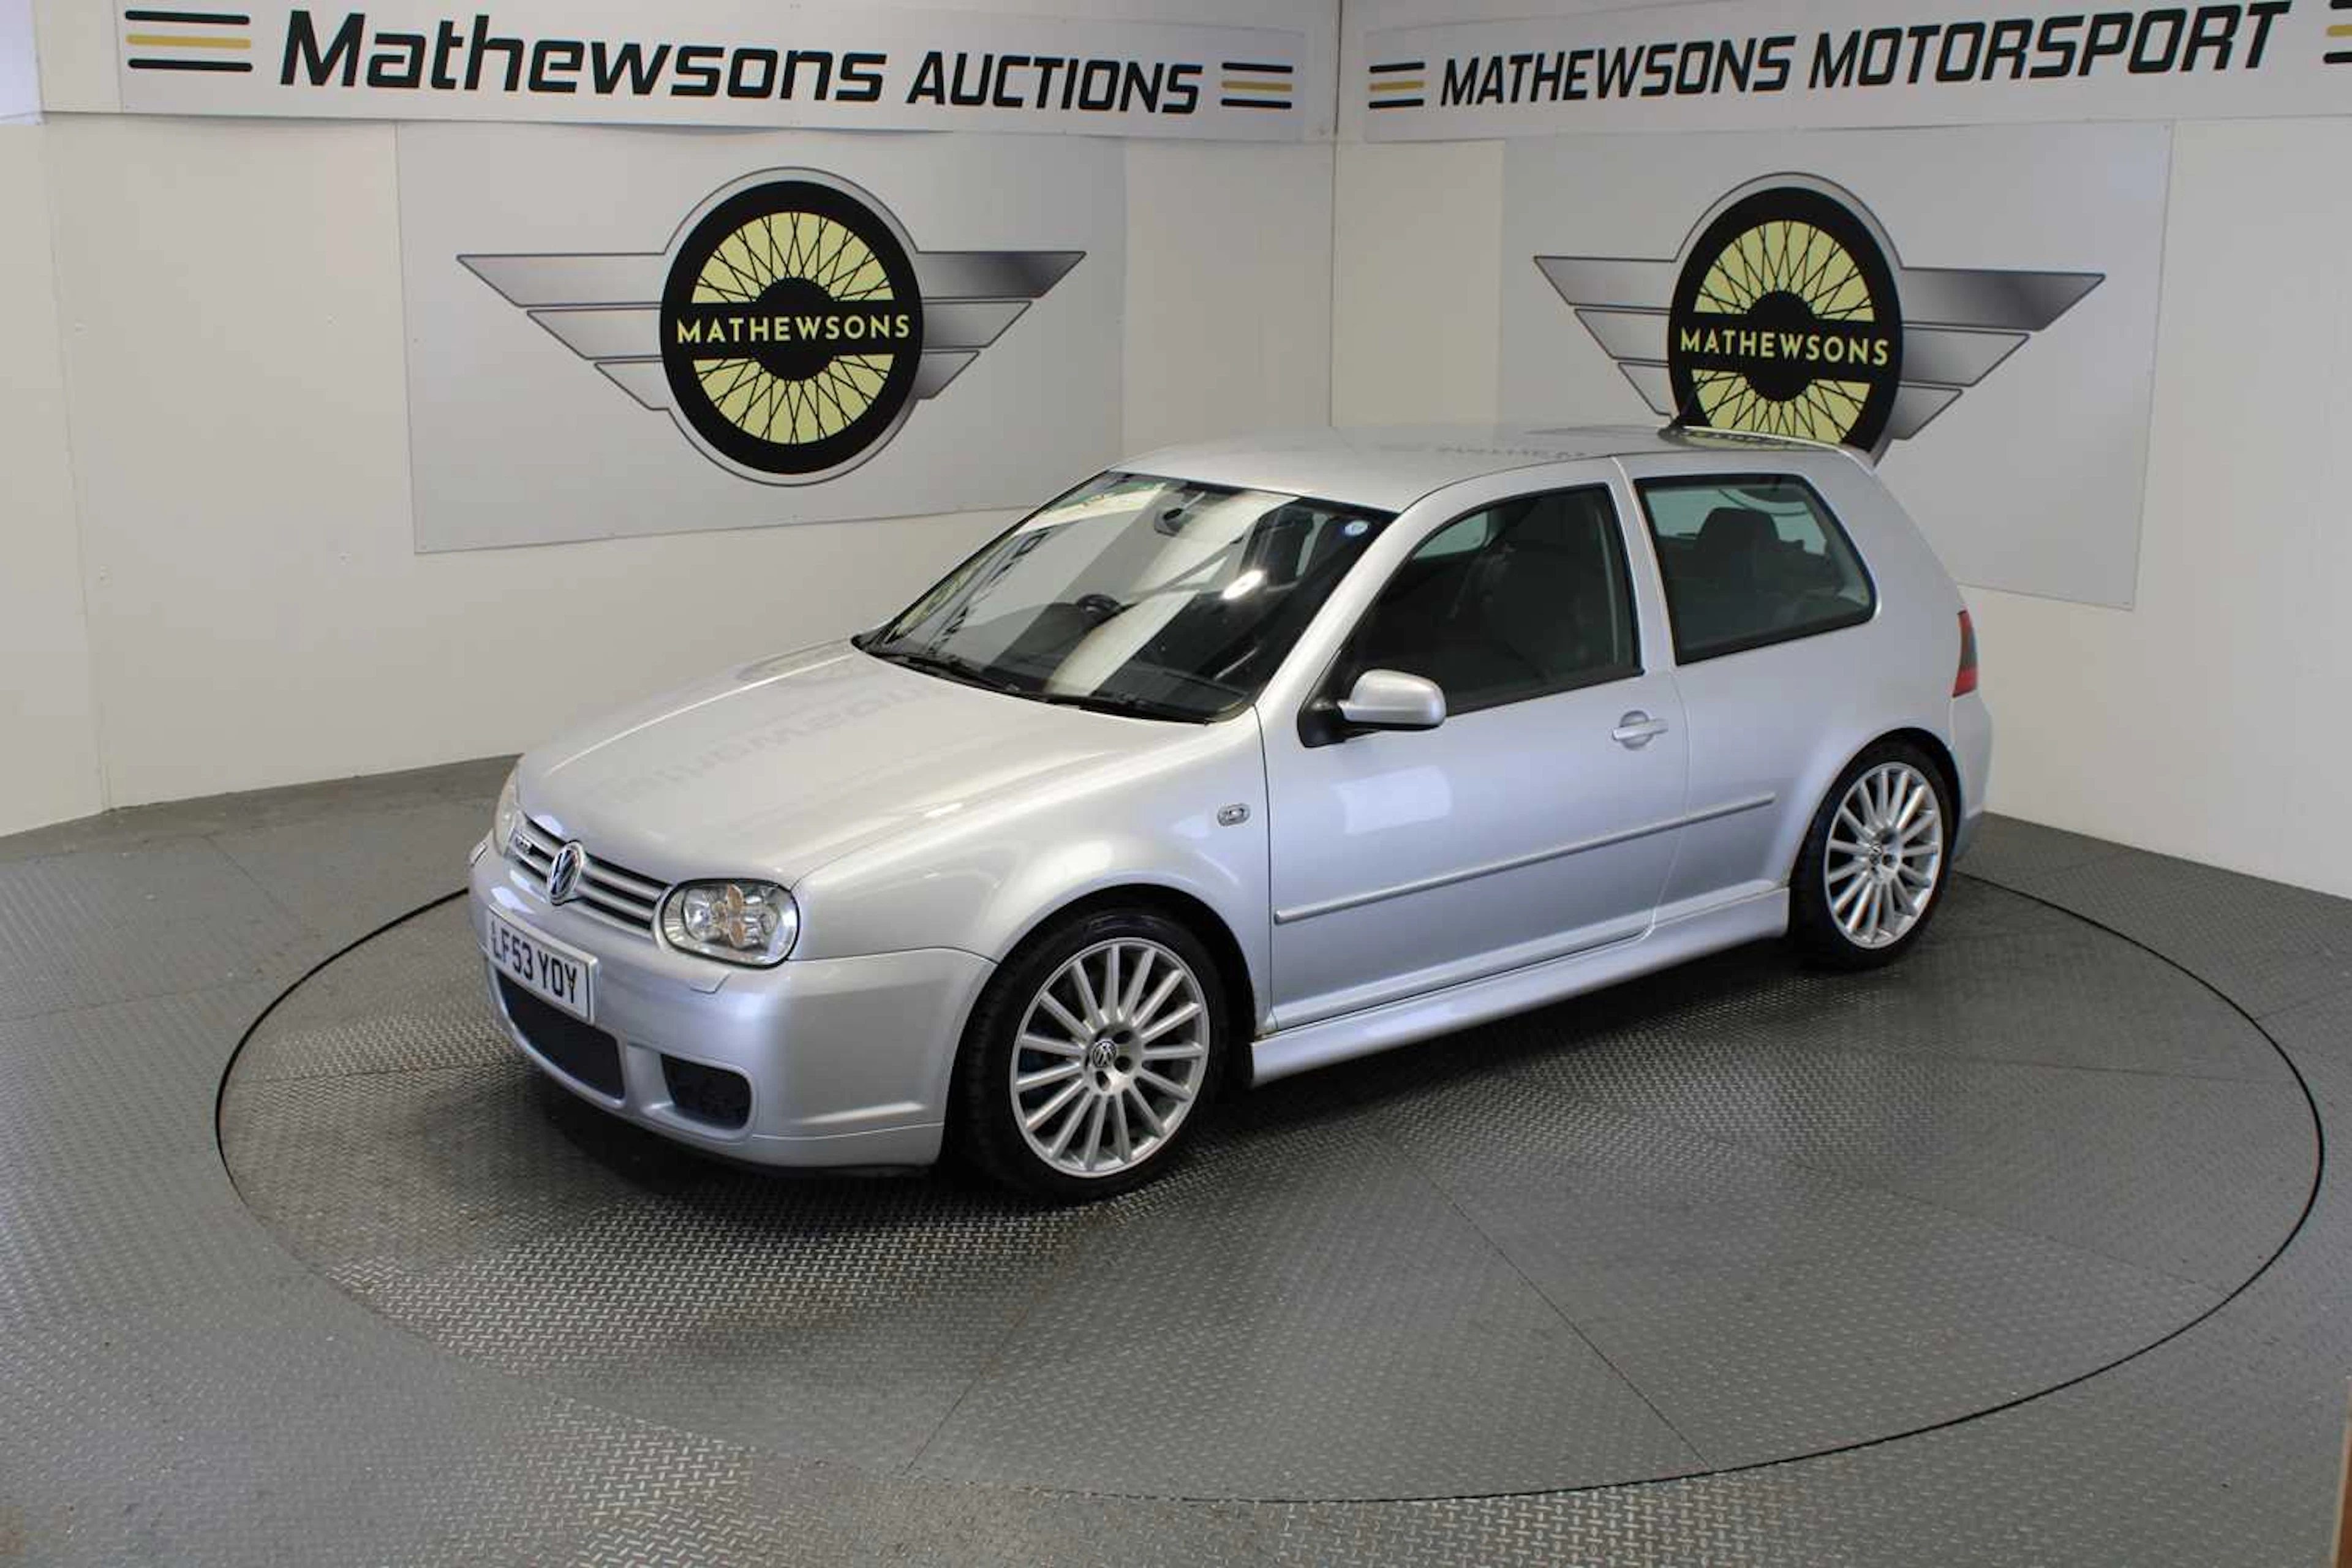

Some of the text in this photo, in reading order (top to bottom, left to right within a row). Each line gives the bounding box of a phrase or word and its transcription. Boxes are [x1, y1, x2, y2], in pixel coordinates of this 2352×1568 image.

[281, 10, 1202, 114] Mathewsons AUCTIONS
[1441, 1, 2291, 107] MATHEWSONS MOTORSPORT
[677, 314, 910, 344] MATHEWSONS
[1679, 327, 1889, 366] MATHEWSONS
[491, 921, 533, 981] LF53
